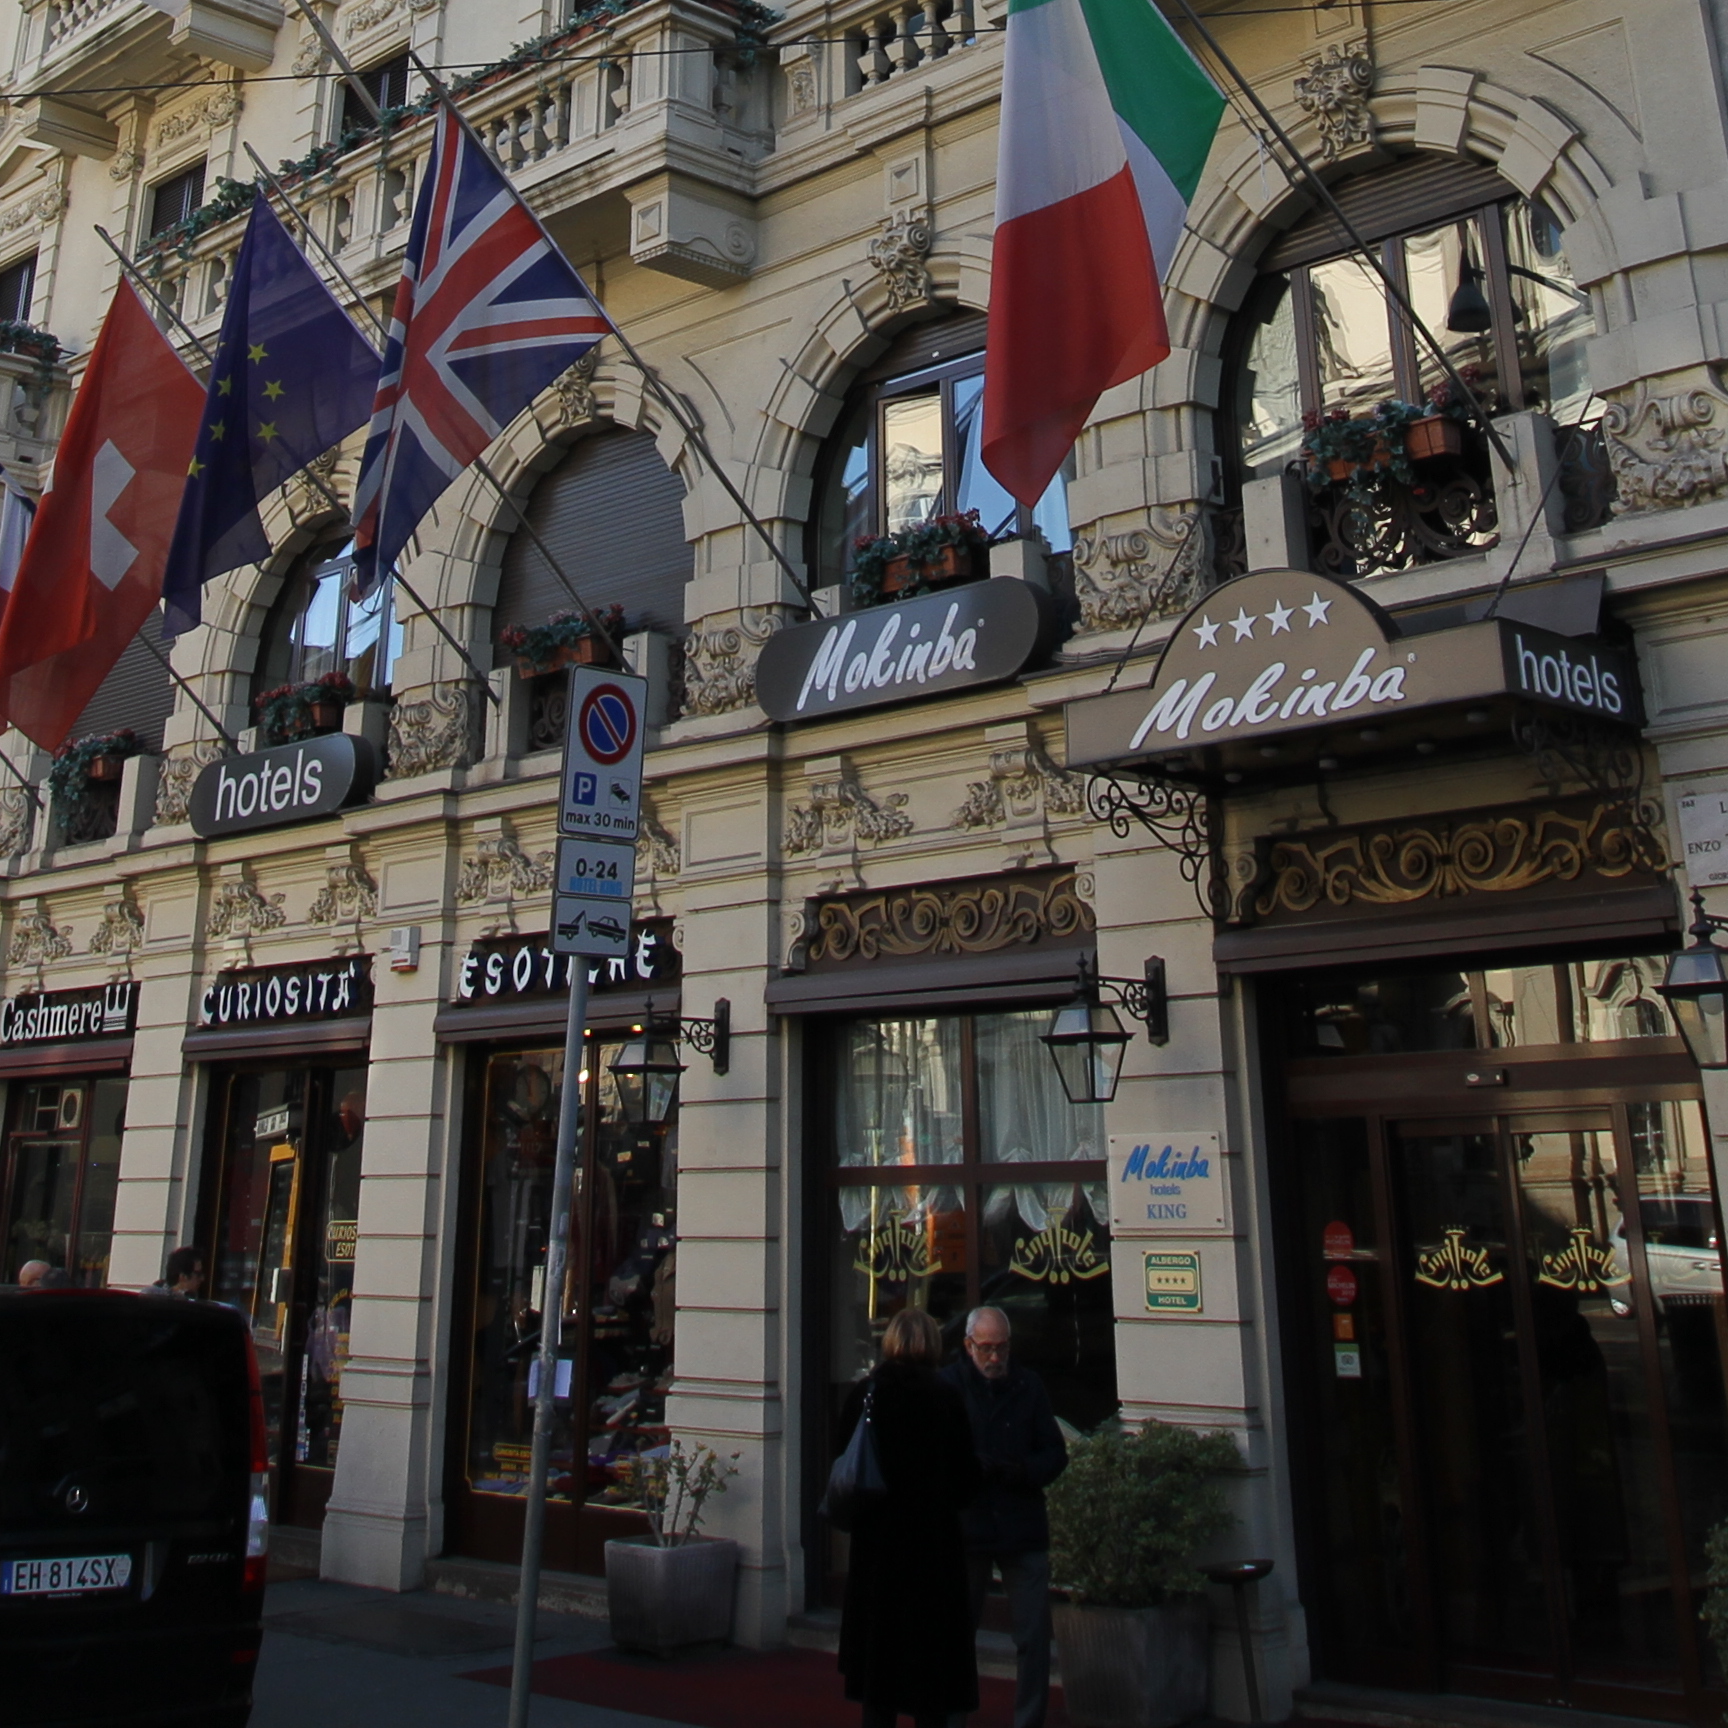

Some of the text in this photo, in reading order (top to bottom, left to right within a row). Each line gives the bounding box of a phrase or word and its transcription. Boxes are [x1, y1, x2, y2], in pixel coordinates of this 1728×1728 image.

[796, 602, 976, 711] Mokinba
[1128, 633, 1623, 750] Mokinba hotels
[214, 748, 322, 821] hotels
[565, 811, 635, 830] max 30 min
[1687, 839, 1722, 855] ENZO
[575, 858, 618, 880] 0-24
[459, 927, 657, 999] ESOTIHE
[0, 994, 102, 1043] Cashmere
[1120, 1143, 1210, 1183] Mokinba
[1149, 1183, 1181, 1196] hotels
[1146, 1203, 1187, 1219] KING
[1150, 1255, 1192, 1265] ALBERGO
[1157, 1295, 1188, 1305] HOTEL
[15, 1561, 42, 1590] EH
[49, 1557, 115, 1588] 814SX
